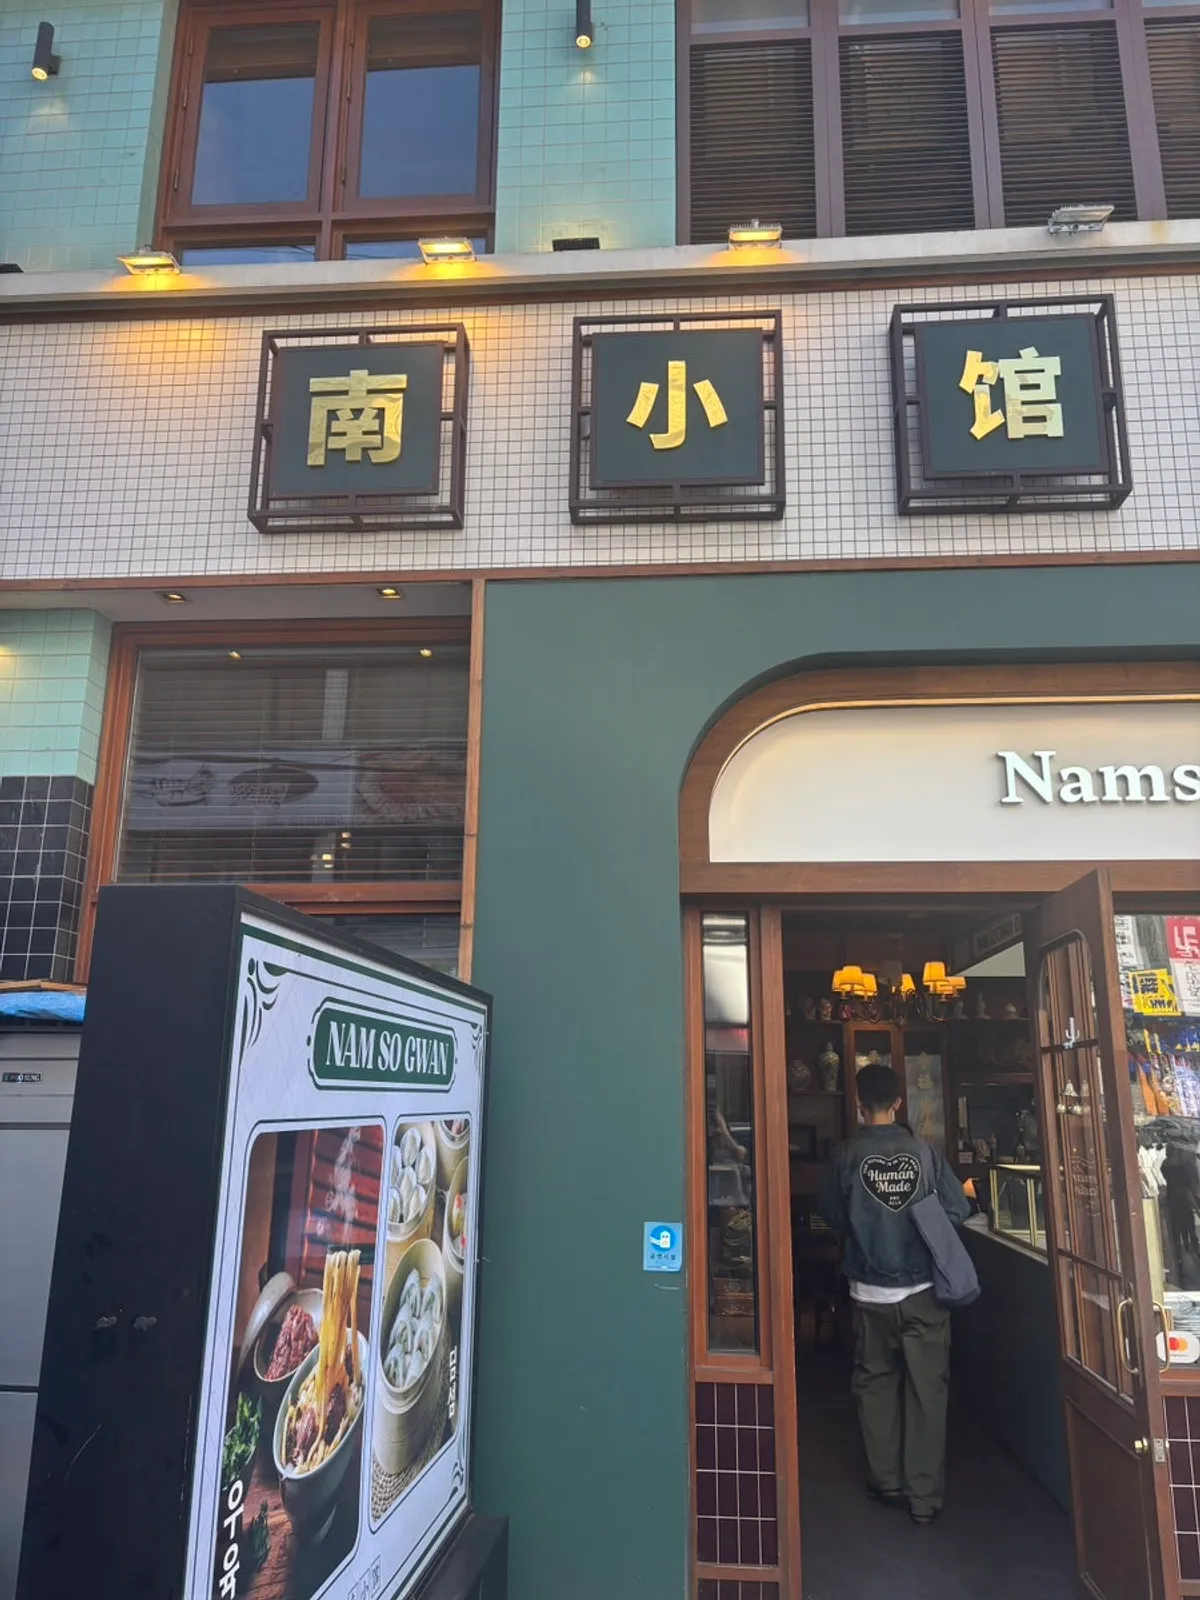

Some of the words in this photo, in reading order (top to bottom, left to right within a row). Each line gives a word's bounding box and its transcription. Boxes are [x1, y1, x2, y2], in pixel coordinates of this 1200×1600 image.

[996, 750, 1200, 803] Nams
[326, 1021, 376, 1069] NAM
[378, 1030, 402, 1072] SO
[404, 1035, 449, 1076] GWAN
[867, 1169, 916, 1182] Human
[876, 1181, 912, 1194] Made
